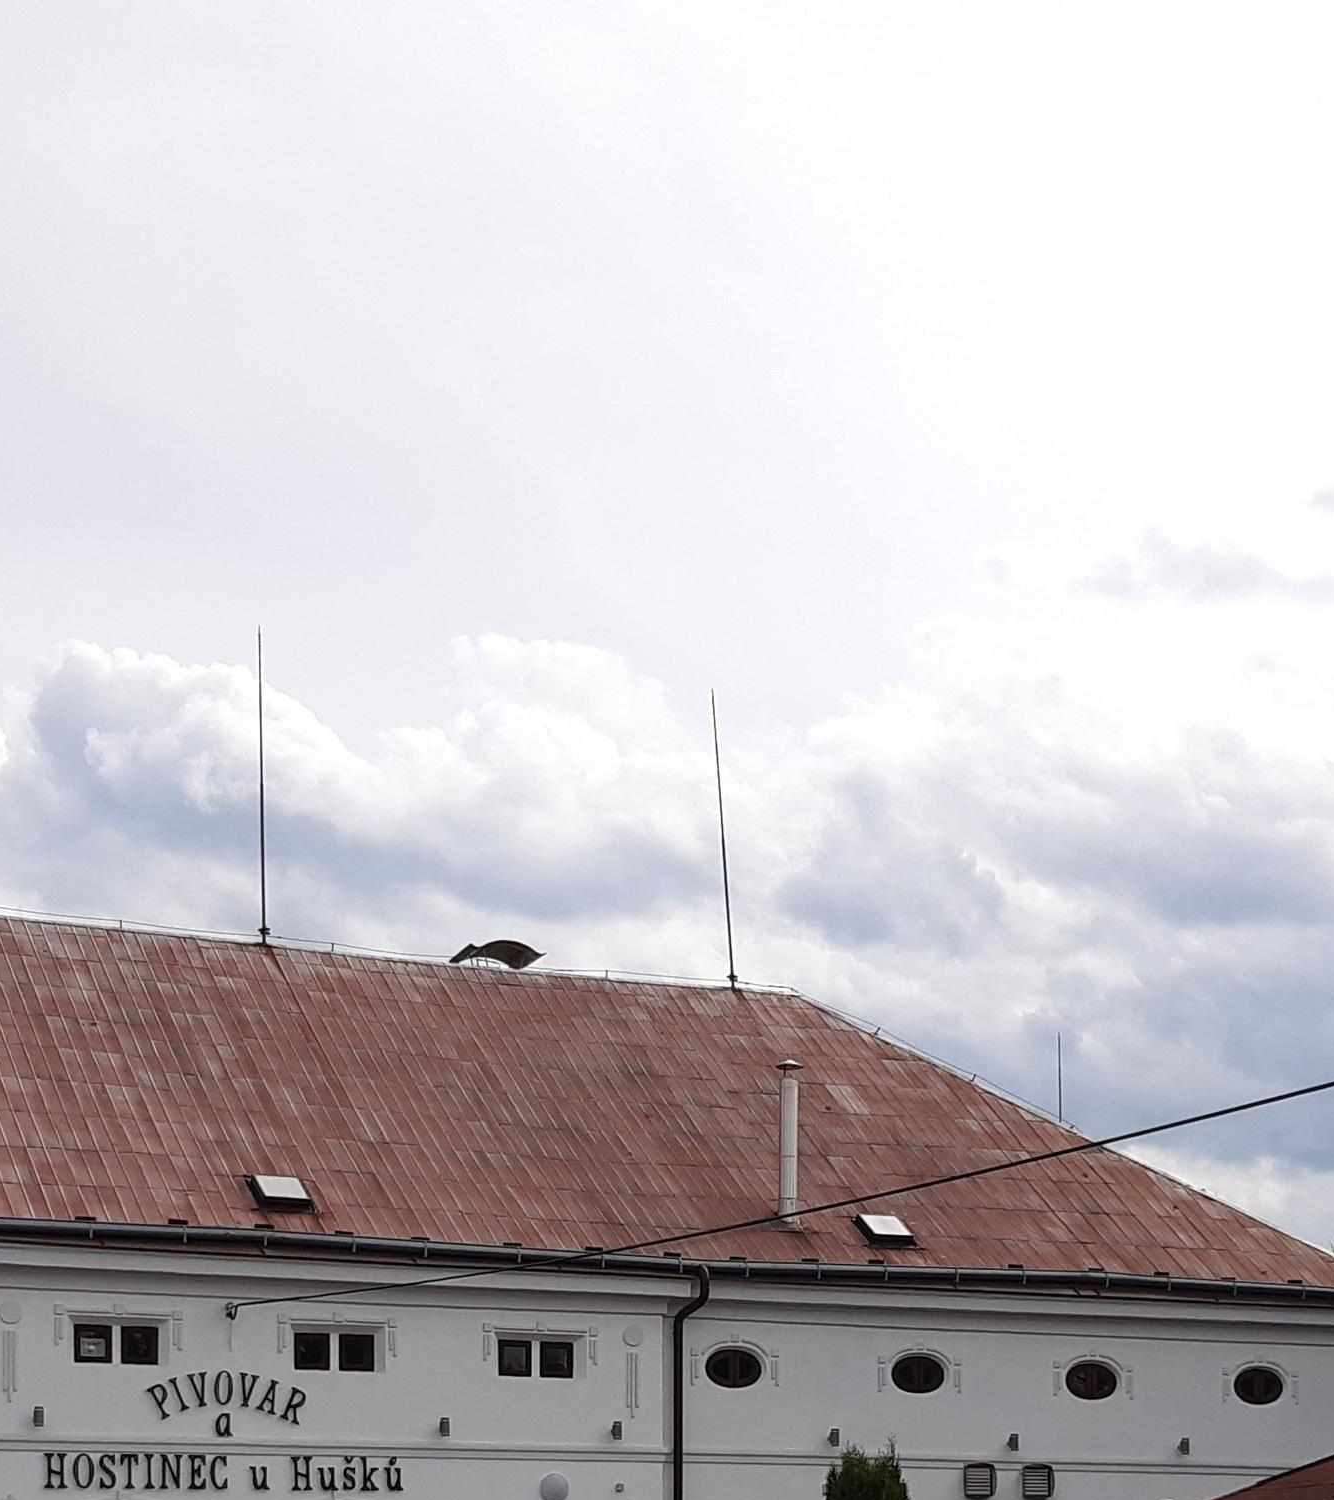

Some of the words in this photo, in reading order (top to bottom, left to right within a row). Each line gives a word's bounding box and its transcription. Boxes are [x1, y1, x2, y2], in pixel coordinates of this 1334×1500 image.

[146, 1370, 308, 1426] PIVOVAR
[214, 1412, 234, 1438] a
[43, 1452, 229, 1491] HOSTINEC
[249, 1465, 271, 1491] u
